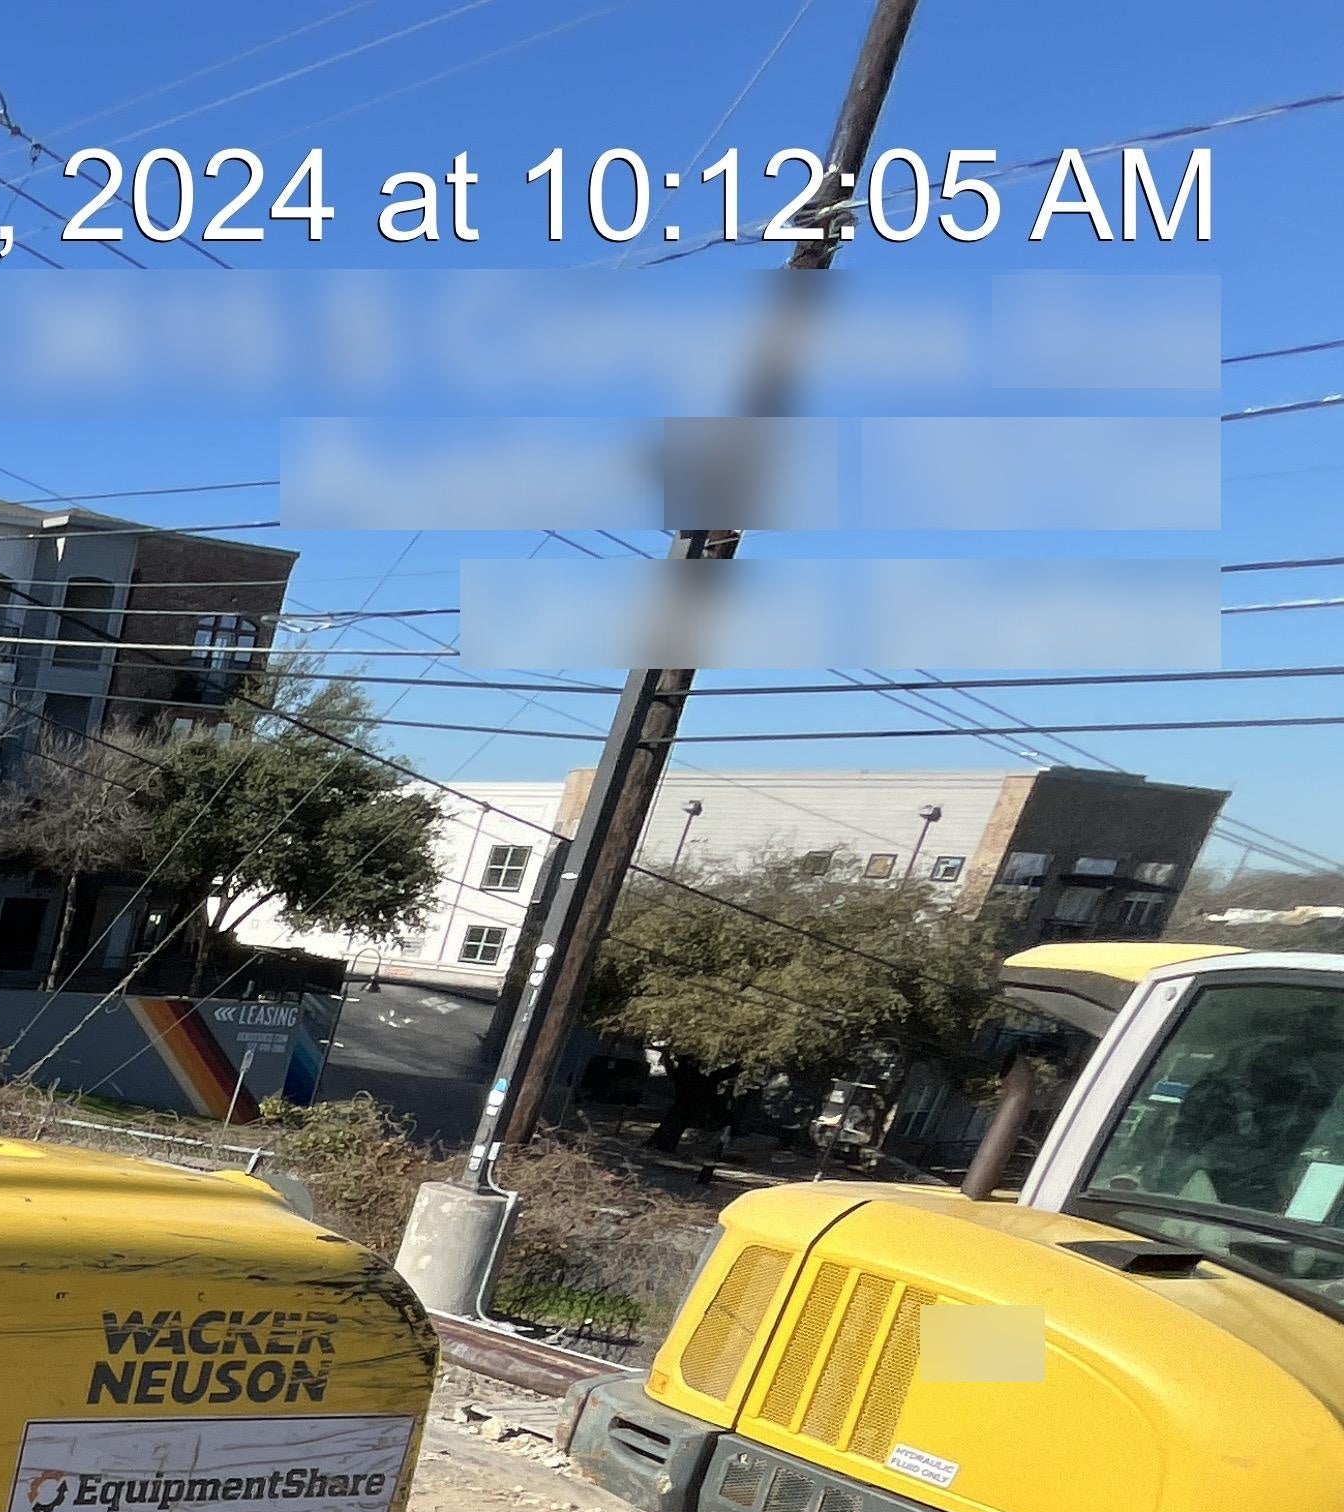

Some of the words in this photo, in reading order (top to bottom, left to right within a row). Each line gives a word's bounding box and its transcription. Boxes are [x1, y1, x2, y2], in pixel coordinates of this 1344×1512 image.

[238, 1005, 299, 1027] LEASING
[101, 1310, 340, 1355] WACKER
[86, 1360, 331, 1405] NEUSON
[73, 1467, 386, 1512] EquipmentShare
